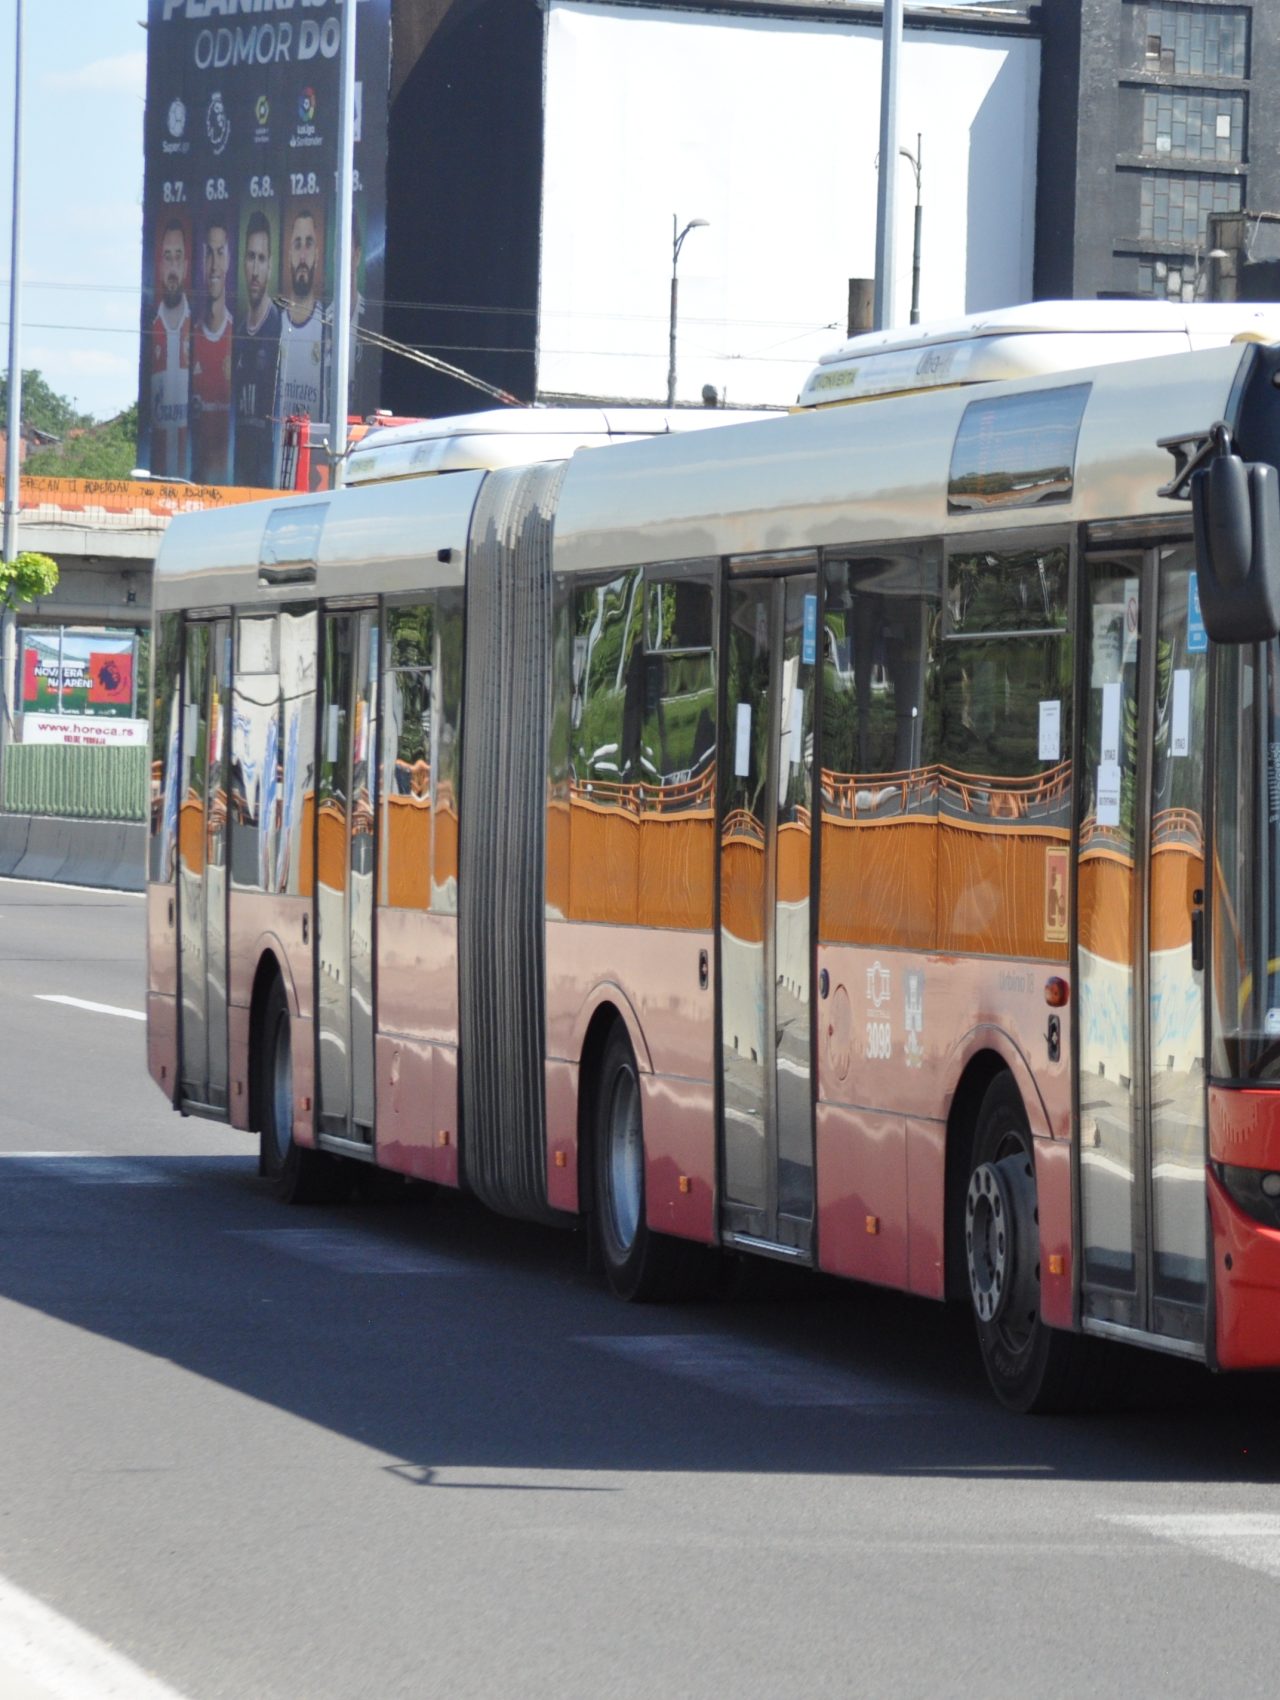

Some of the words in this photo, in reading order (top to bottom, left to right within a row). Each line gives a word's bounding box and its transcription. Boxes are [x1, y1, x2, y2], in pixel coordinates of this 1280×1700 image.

[194, 22, 293, 69] ODMOR
[297, 17, 341, 60] DO
[163, 181, 187, 203] 8.7.
[206, 177, 229, 201] 6.8.
[250, 175, 275, 198] 6.8.
[290, 172, 320, 195] 12.8.
[37, 723, 135, 737] www.horeca.rs
[866, 1022, 892, 1060] 3098
